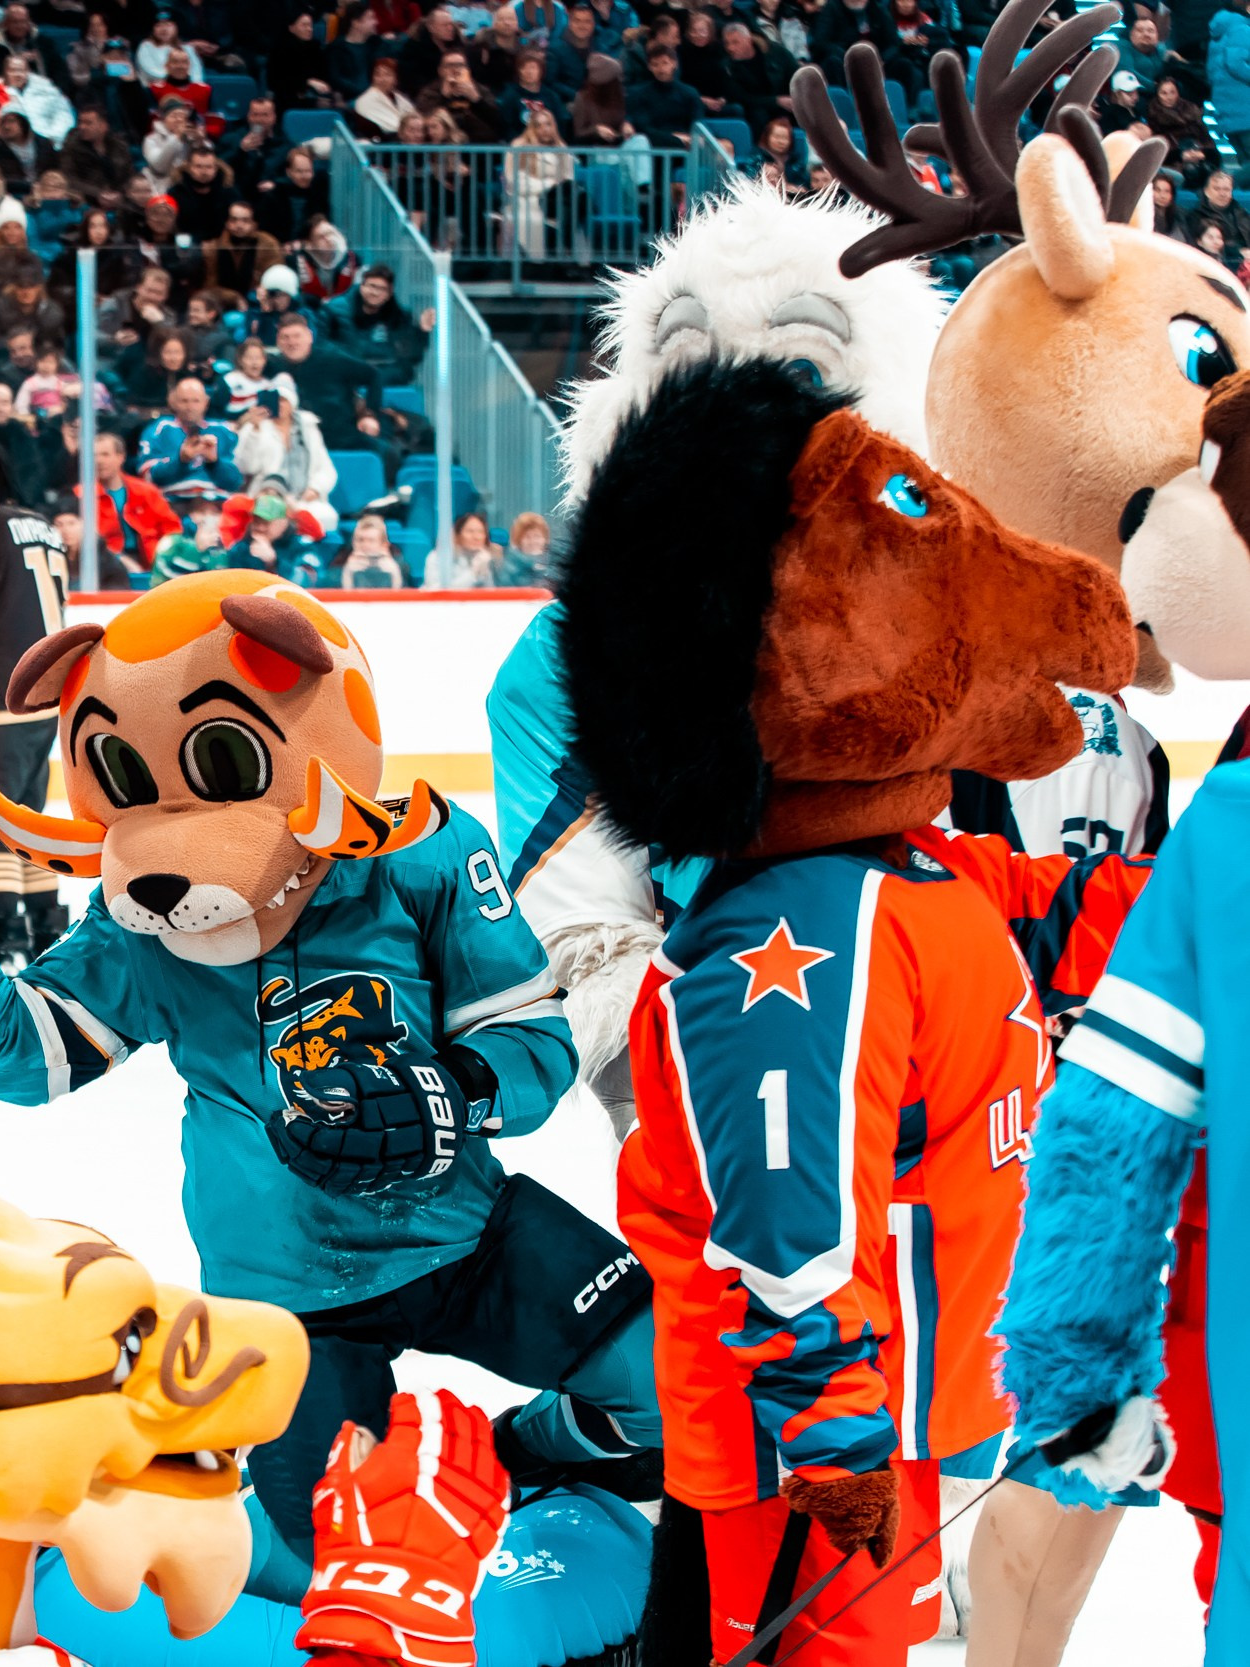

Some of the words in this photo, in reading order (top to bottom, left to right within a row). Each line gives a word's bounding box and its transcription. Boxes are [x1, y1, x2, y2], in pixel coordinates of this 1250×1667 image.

[466, 848, 513, 923] 9
[409, 1065, 456, 1181] BAUE
[756, 1068, 791, 1171] 1
[573, 1252, 641, 1314] CCM
